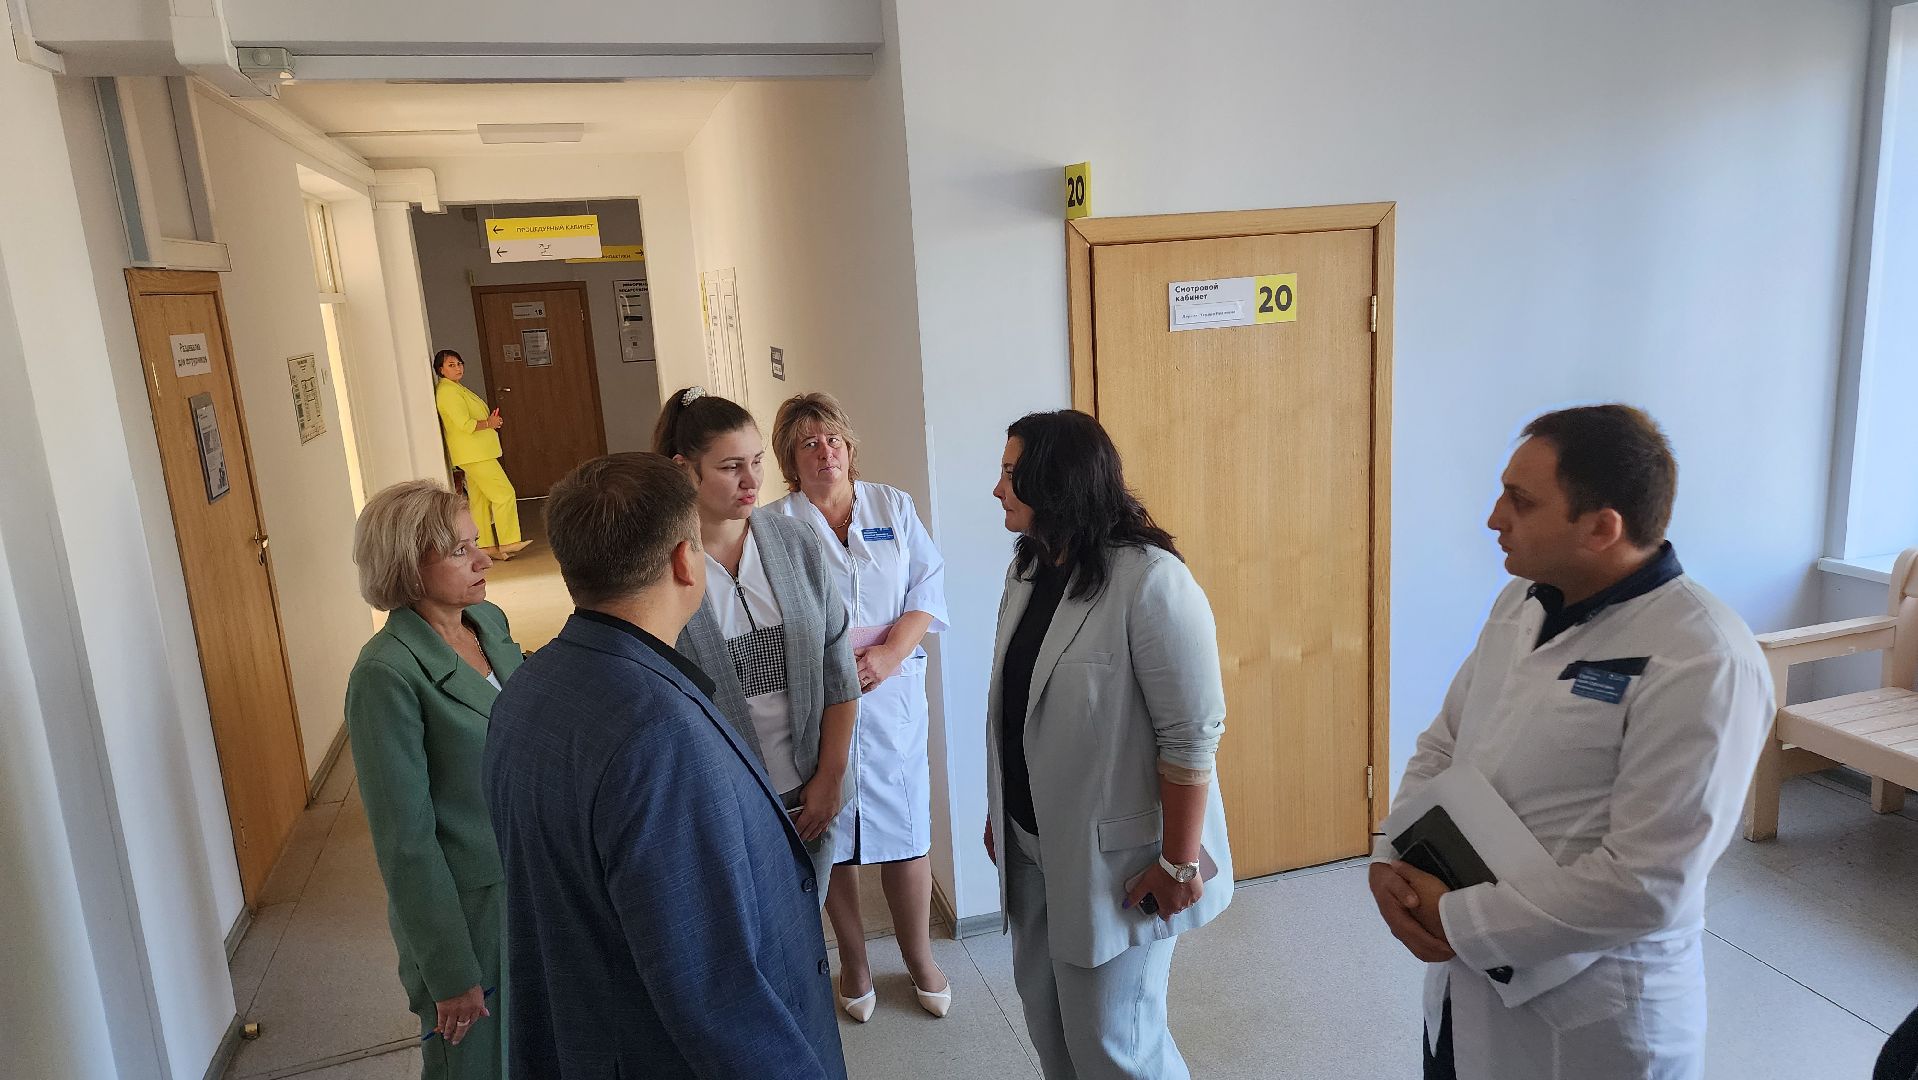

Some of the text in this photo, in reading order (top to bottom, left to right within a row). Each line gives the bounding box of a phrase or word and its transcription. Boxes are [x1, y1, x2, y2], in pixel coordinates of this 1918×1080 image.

[1067, 175, 1085, 207] 20
[516, 223, 594, 233] ПРОЦЕДУРНЫЙ КАБИНЕТ
[1175, 282, 1219, 294] Смотровой
[1175, 293, 1208, 302] кабинет
[1258, 284, 1293, 313] 20
